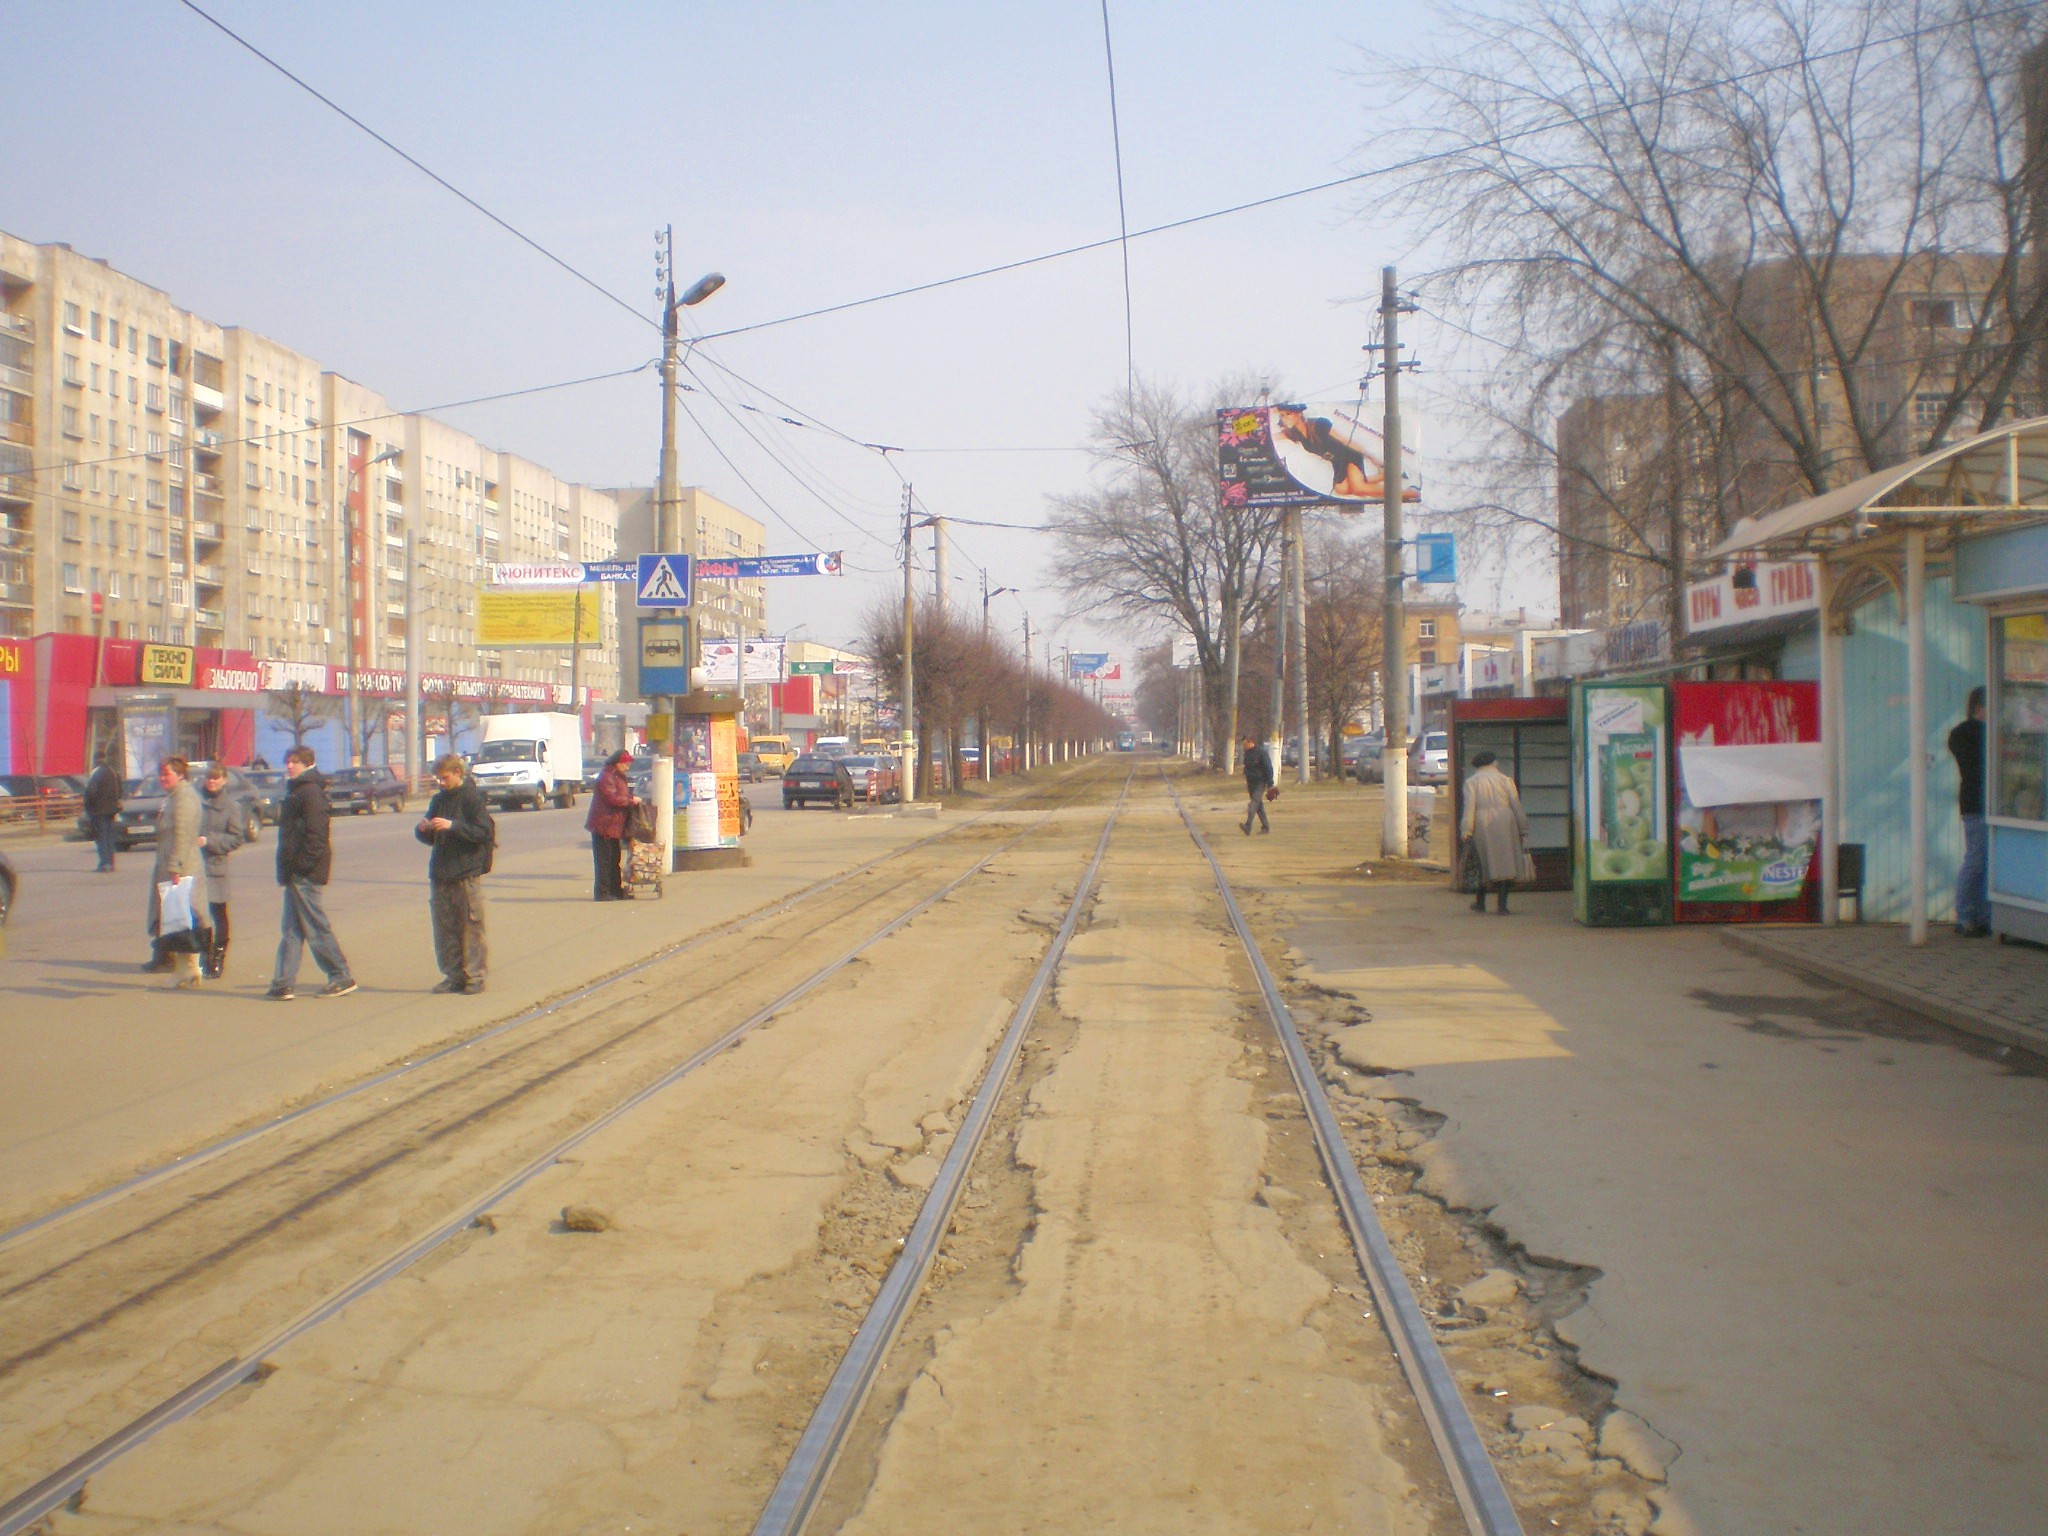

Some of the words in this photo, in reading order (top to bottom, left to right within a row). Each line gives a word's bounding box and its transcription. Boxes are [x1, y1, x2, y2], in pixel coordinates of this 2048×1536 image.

[508, 567, 580, 579] ЮНИТЕКС
[589, 564, 623, 572] МЕБЕЛЬ
[600, 573, 630, 581] БАНКА,
[1770, 562, 1813, 608] ГРИЛЬ
[1692, 585, 1721, 624] КУРЫ
[151, 649, 187, 665] ТЕХНО
[153, 664, 184, 680] СИЛА
